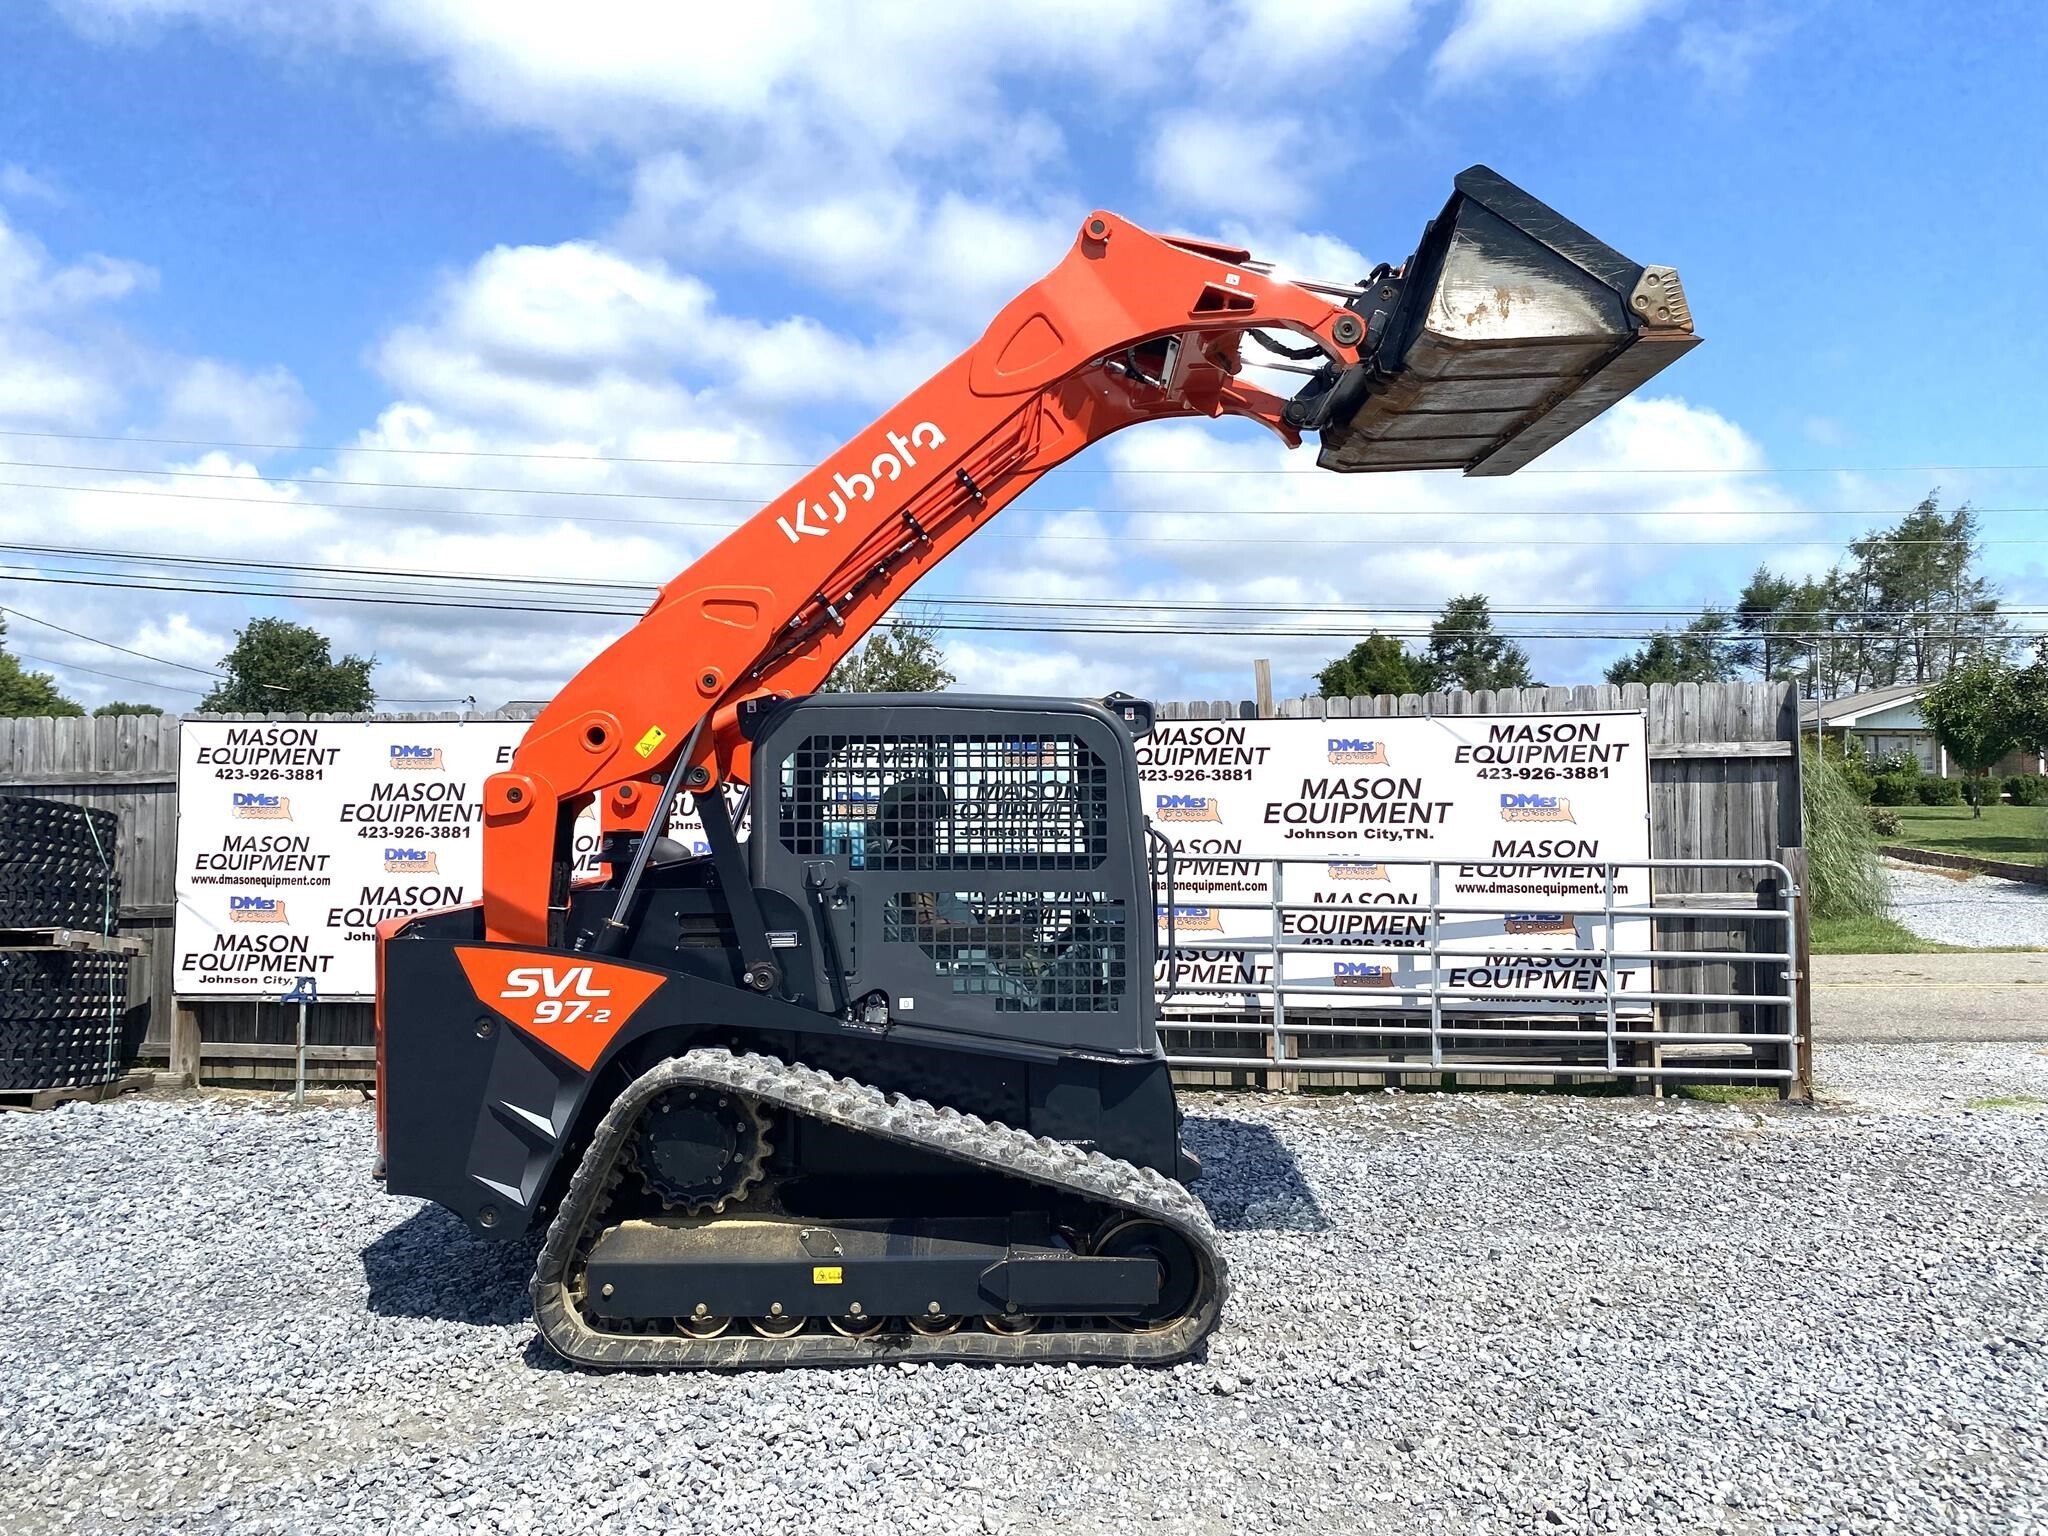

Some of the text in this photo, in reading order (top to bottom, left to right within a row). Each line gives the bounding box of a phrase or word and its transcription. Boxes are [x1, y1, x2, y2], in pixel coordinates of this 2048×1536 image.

[776, 421, 947, 544] Kubota
[226, 728, 318, 746] MASON
[1147, 727, 1246, 745] MASON
[1489, 724, 1600, 743] MASON
[197, 748, 340, 766] EQUIPMENT
[1135, 747, 1271, 766] QUIPMENT
[1454, 744, 1630, 763] EQUIPMENT
[215, 769, 323, 781] 423-926-3881
[1138, 769, 1252, 781] 423-926-3881
[1476, 767, 1610, 780] 423-926-3881
[370, 782, 466, 801] MASON
[1300, 778, 1422, 800] MASON
[340, 804, 484, 822] EQUIPMENT
[1263, 802, 1454, 824] EQUIPMENT
[358, 826, 471, 839] 423-926-3881
[1284, 828, 1435, 842] Johnson City,TN.
[222, 836, 310, 853] MASON
[1491, 840, 1599, 858] MASON
[195, 854, 330, 872] EQUIPMENT
[191, 874, 331, 886] www.dmasonequipment.com
[359, 886, 463, 906] MASON
[213, 934, 309, 952] MASON
[1301, 938, 1426, 948] 4239263881
[182, 953, 334, 973] EQUIPMENT
[1157, 950, 1245, 962] ASON
[198, 975, 300, 986] Johnson City,
[500, 967, 611, 998] SVL
[1448, 968, 1636, 990] EQUIPMENT
[532, 1000, 612, 1024] 97-2
